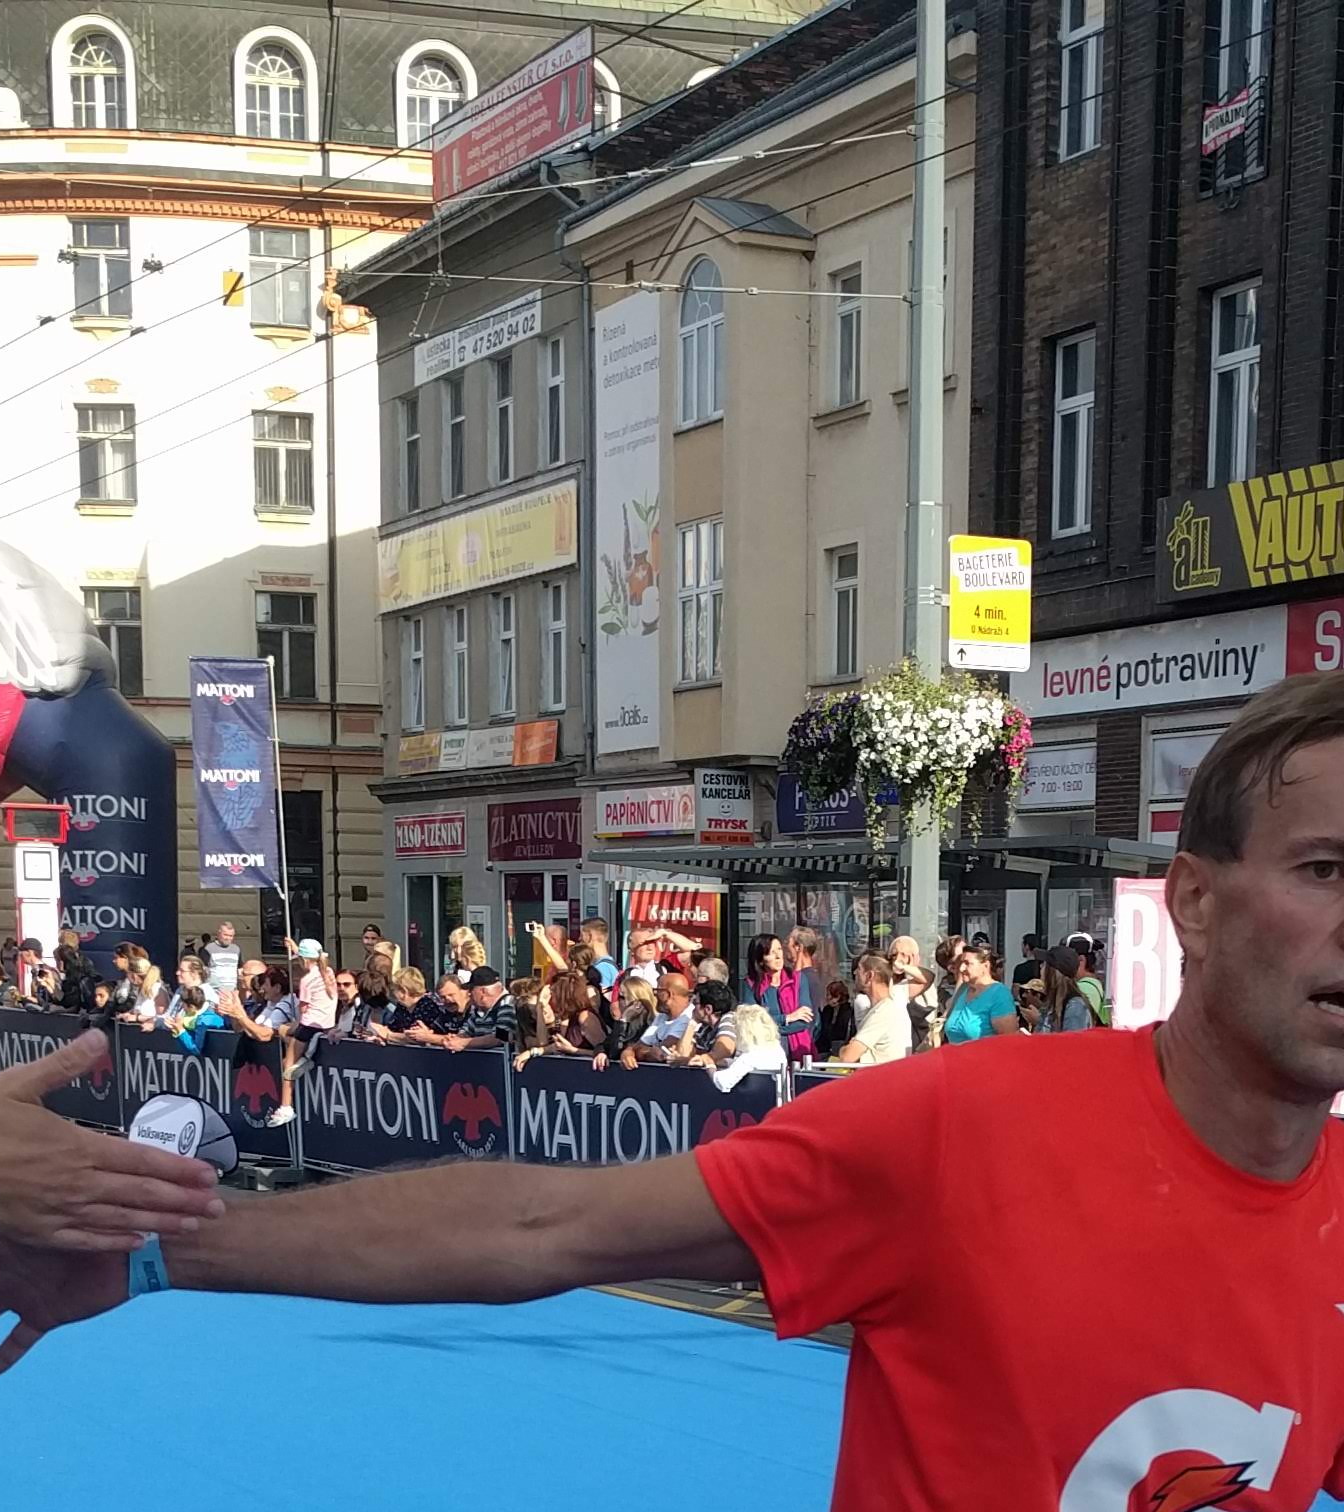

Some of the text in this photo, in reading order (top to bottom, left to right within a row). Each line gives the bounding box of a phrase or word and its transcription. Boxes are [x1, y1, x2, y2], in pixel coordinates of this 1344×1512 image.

[472, 336, 484, 355] 47
[486, 327, 504, 351] 520
[506, 320, 519, 341] 94
[522, 312, 536, 334] 02
[958, 552, 1014, 572] BAGETERIE
[964, 571, 1025, 588] BOULEVARD
[974, 605, 1008, 621] 4 min.
[1043, 638, 1259, 701] levné potraviny
[196, 683, 254, 698] MATTONI
[201, 768, 260, 784] MATTONI
[702, 773, 749, 788] CESTOVNÍ
[1029, 763, 1060, 779] TEVŘENO
[702, 785, 751, 801] KANCELÁŘ
[54, 793, 148, 821] ATTONI
[605, 791, 676, 827] PAPÍRNICTVÍ
[396, 822, 463, 849] MASO-UZENINY
[706, 818, 748, 832] TRYSK
[60, 849, 148, 877] ATTONI
[205, 853, 265, 868] MATTONI
[60, 904, 148, 932] ATTONI
[647, 903, 710, 924] Kontrola
[123, 1048, 232, 1115] MATTONI
[304, 1066, 439, 1145] MATTONI
[137, 1123, 177, 1145] Volkswagen
[520, 1087, 691, 1167] MATTONI
